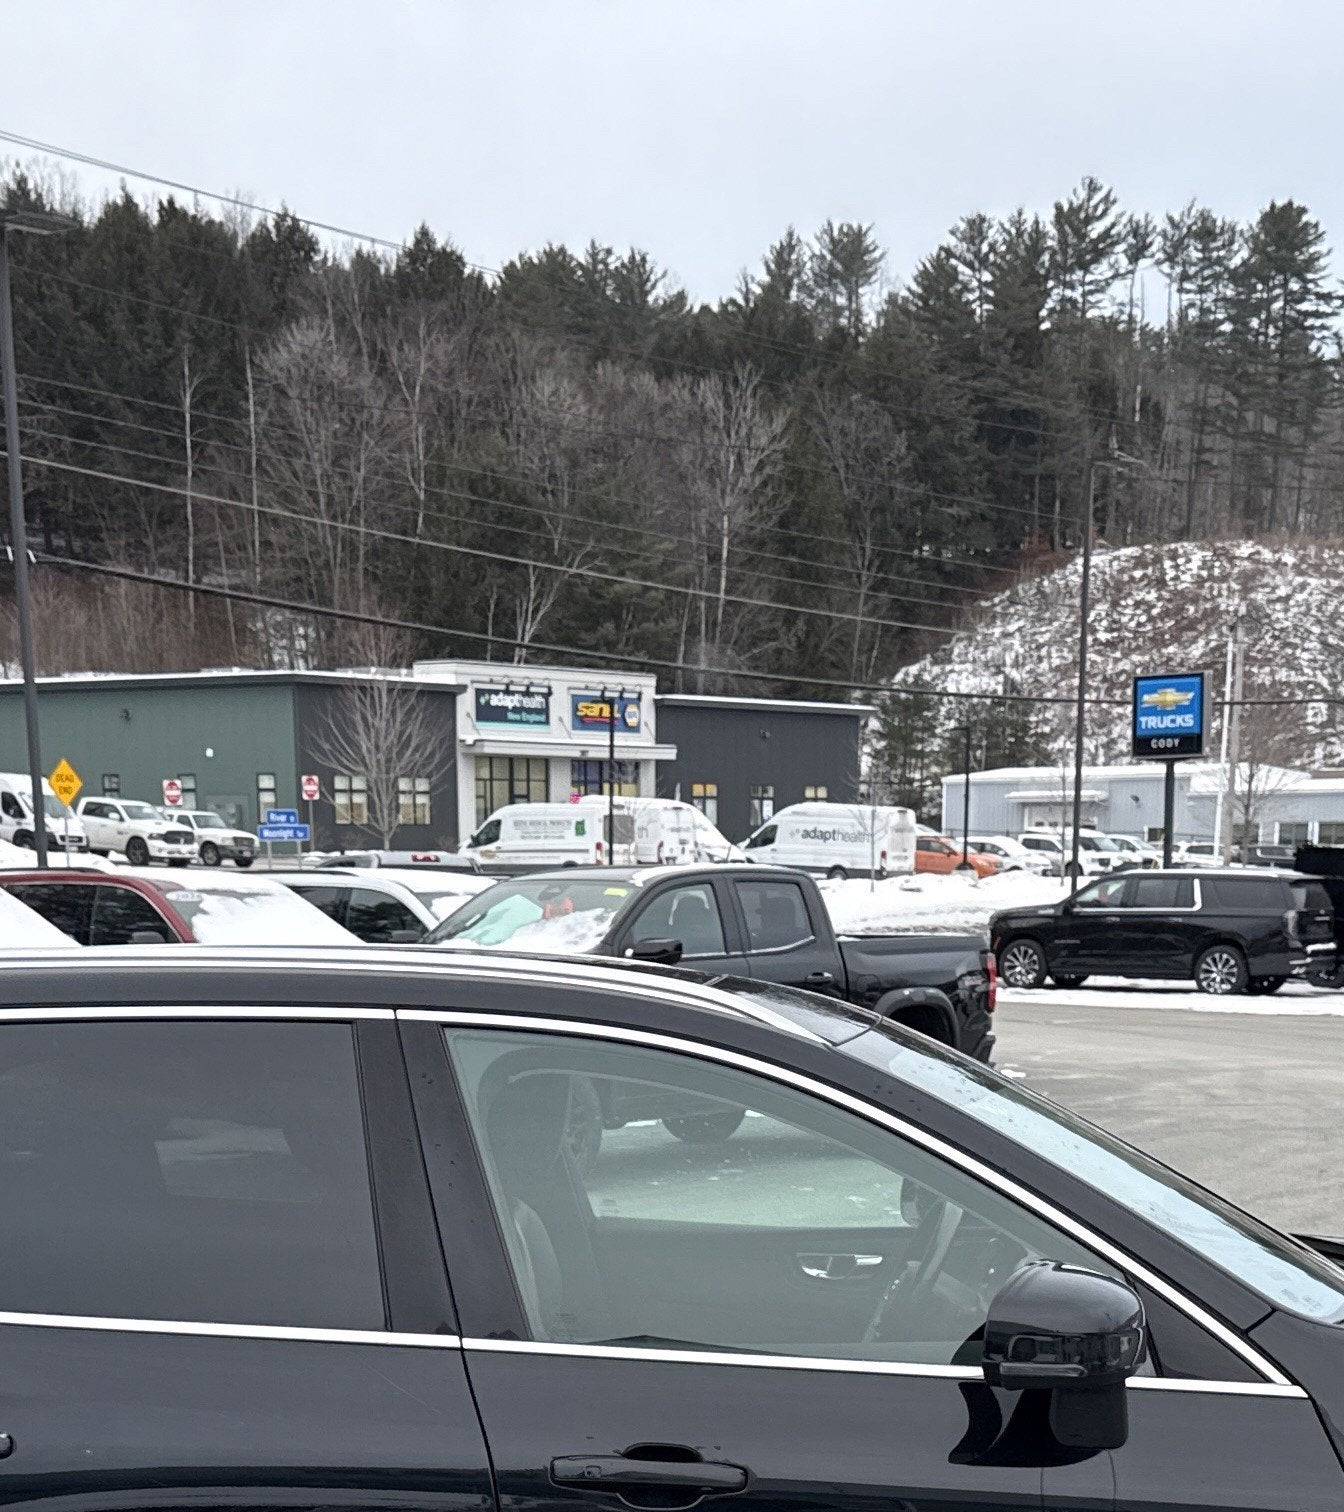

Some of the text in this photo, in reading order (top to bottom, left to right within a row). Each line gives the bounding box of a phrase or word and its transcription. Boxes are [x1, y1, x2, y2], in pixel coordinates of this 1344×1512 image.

[1139, 713, 1195, 730] TRUCKS
[1150, 738, 1181, 749] CODY
[801, 827, 873, 843] adapthealth
